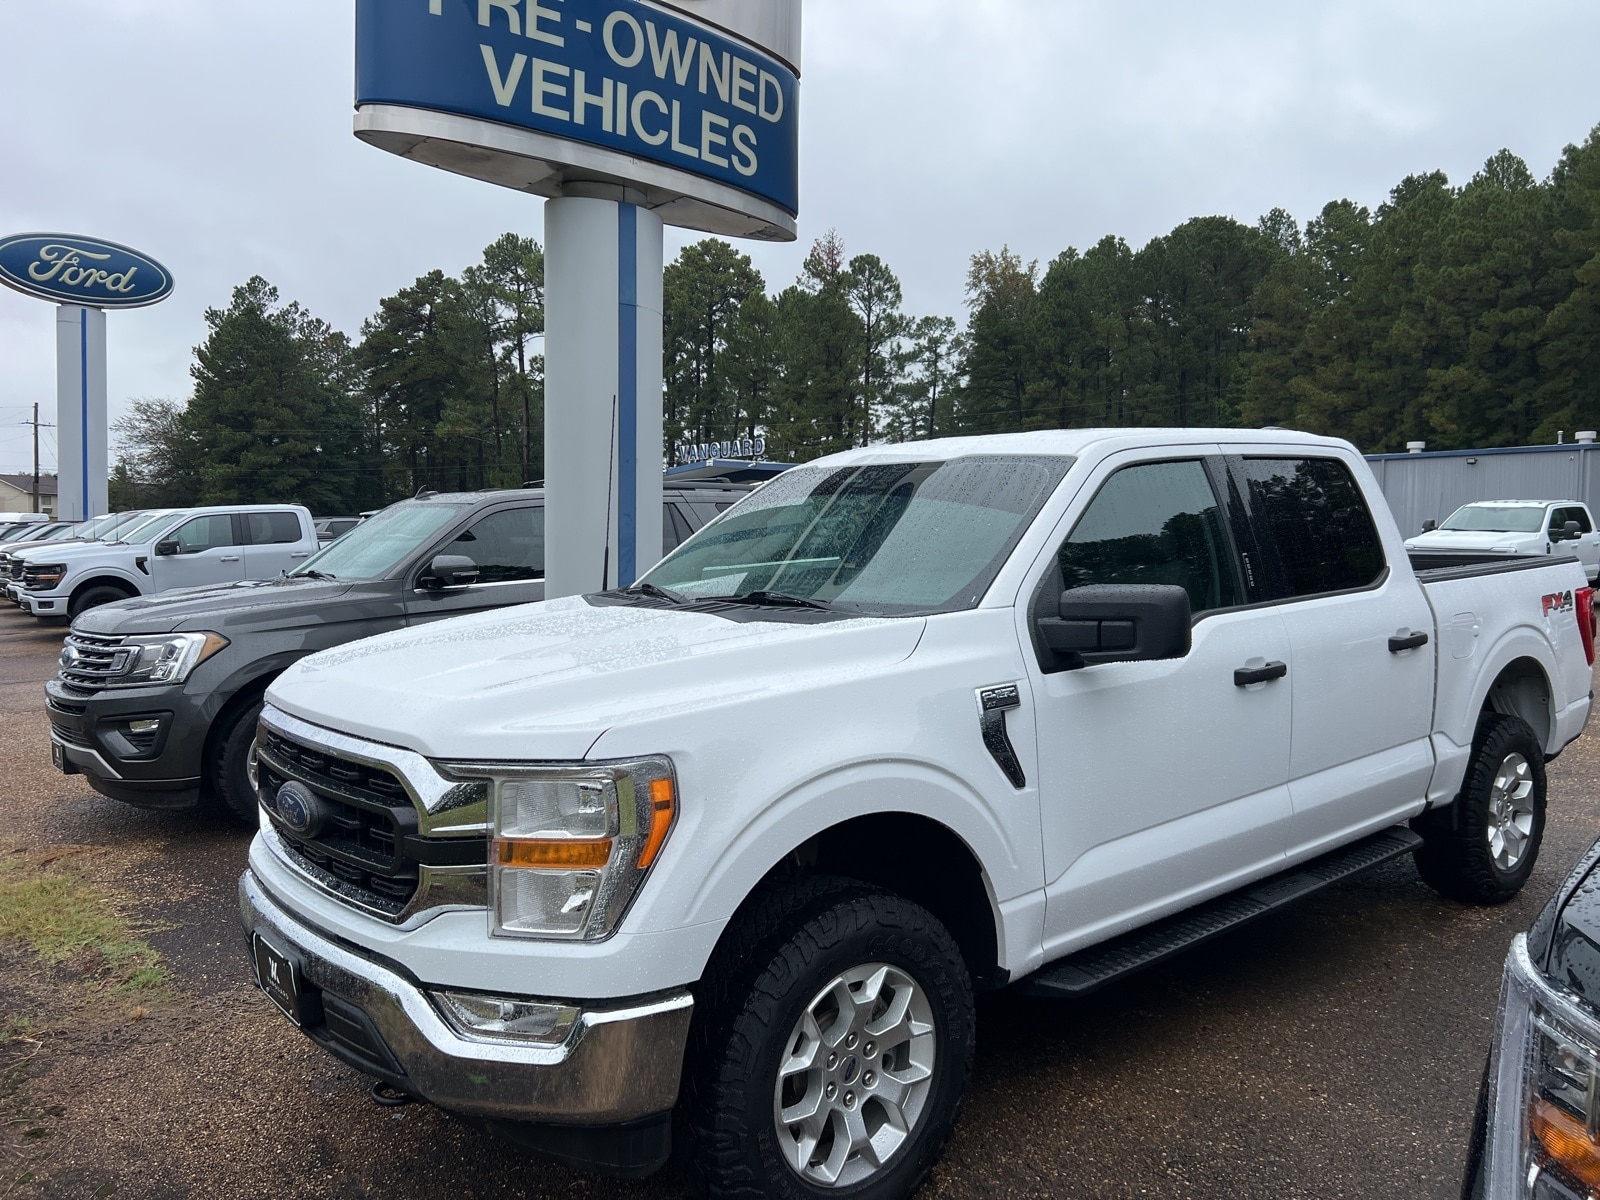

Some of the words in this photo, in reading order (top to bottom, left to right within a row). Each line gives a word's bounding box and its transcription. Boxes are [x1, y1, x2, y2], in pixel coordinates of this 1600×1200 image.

[429, 0, 784, 123] RE-OWNED
[479, 43, 758, 176] VEHICLES
[28, 244, 138, 293] Ford
[680, 438, 766, 461] VANGUARD
[1541, 590, 1573, 617] FX4
